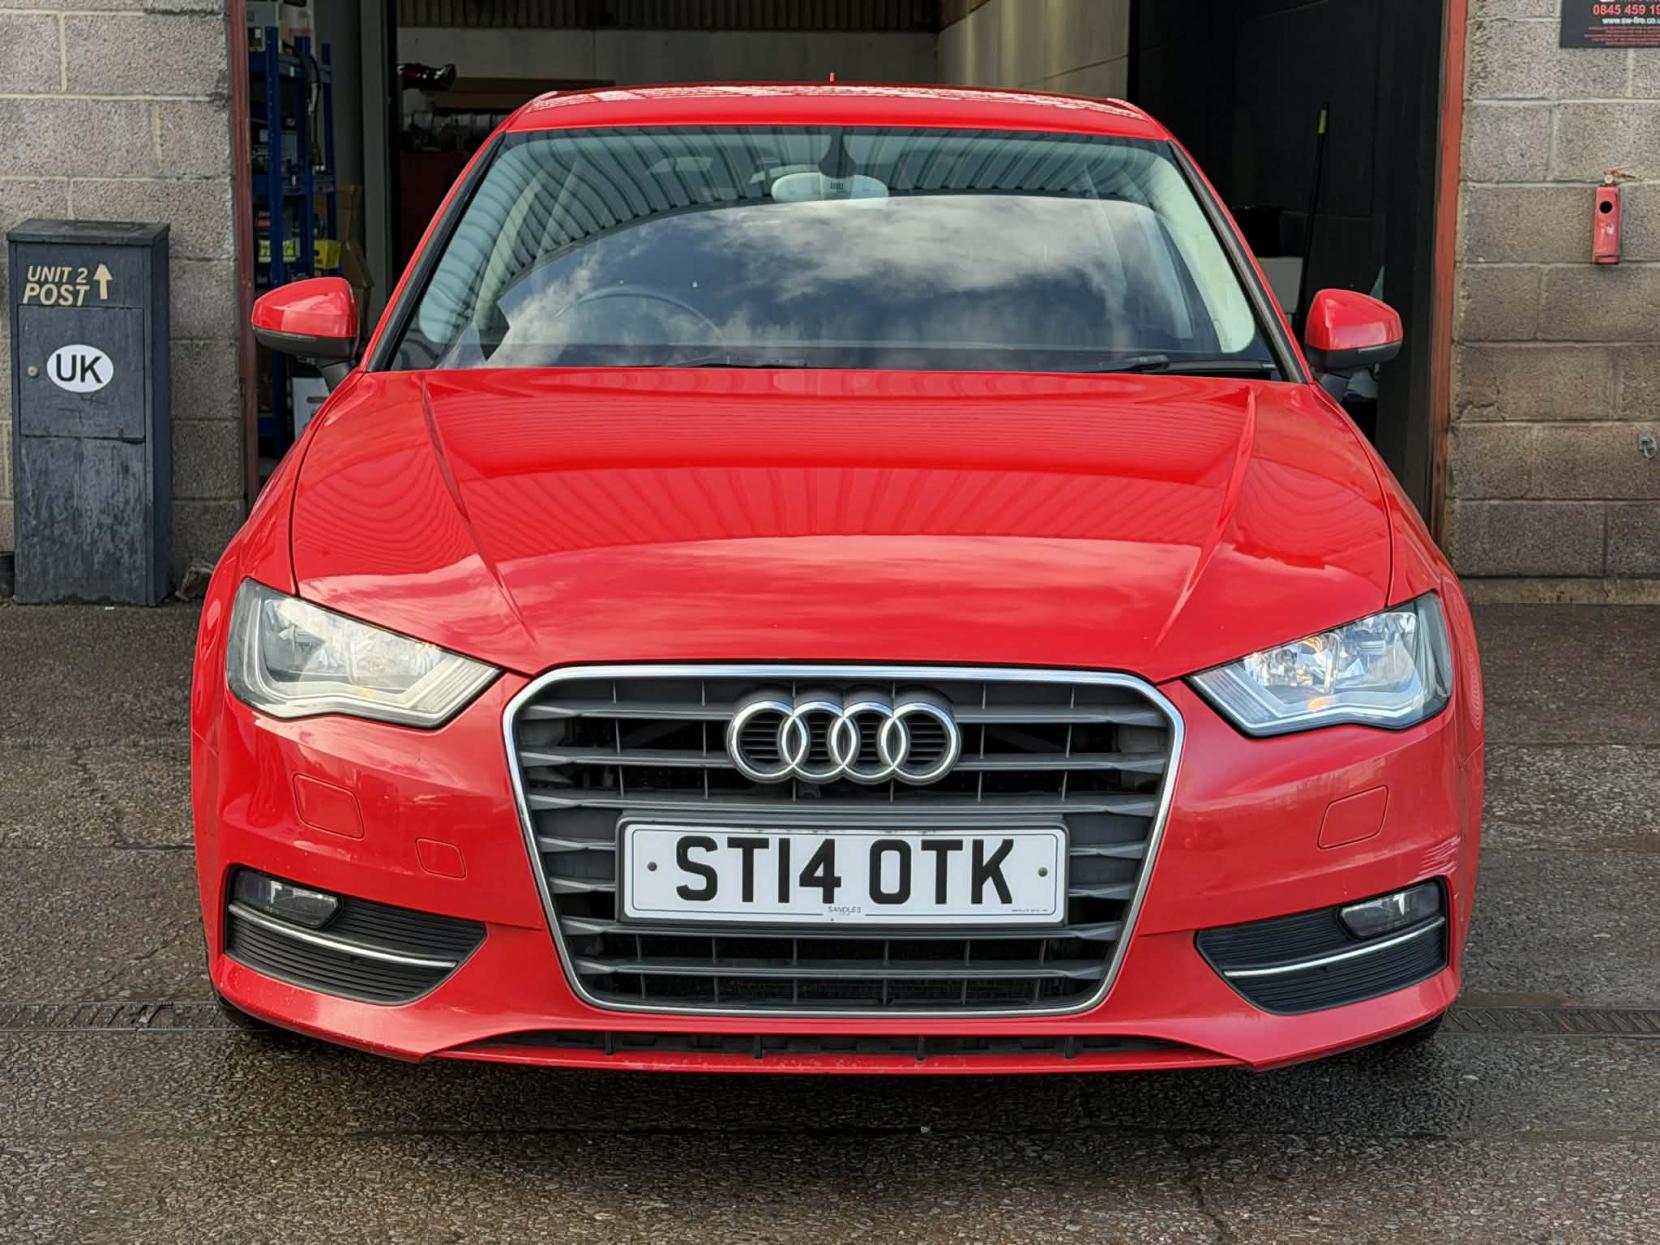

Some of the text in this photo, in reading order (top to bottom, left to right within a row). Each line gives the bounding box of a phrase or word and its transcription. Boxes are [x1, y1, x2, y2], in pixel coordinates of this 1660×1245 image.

[1592, 4, 1622, 15] 0845
[1624, 4, 1646, 15] 459
[27, 265, 89, 283] UNIT 2
[22, 282, 91, 307] POST
[56, 353, 103, 384] UK
[676, 835, 1015, 905] ST14 OTK
